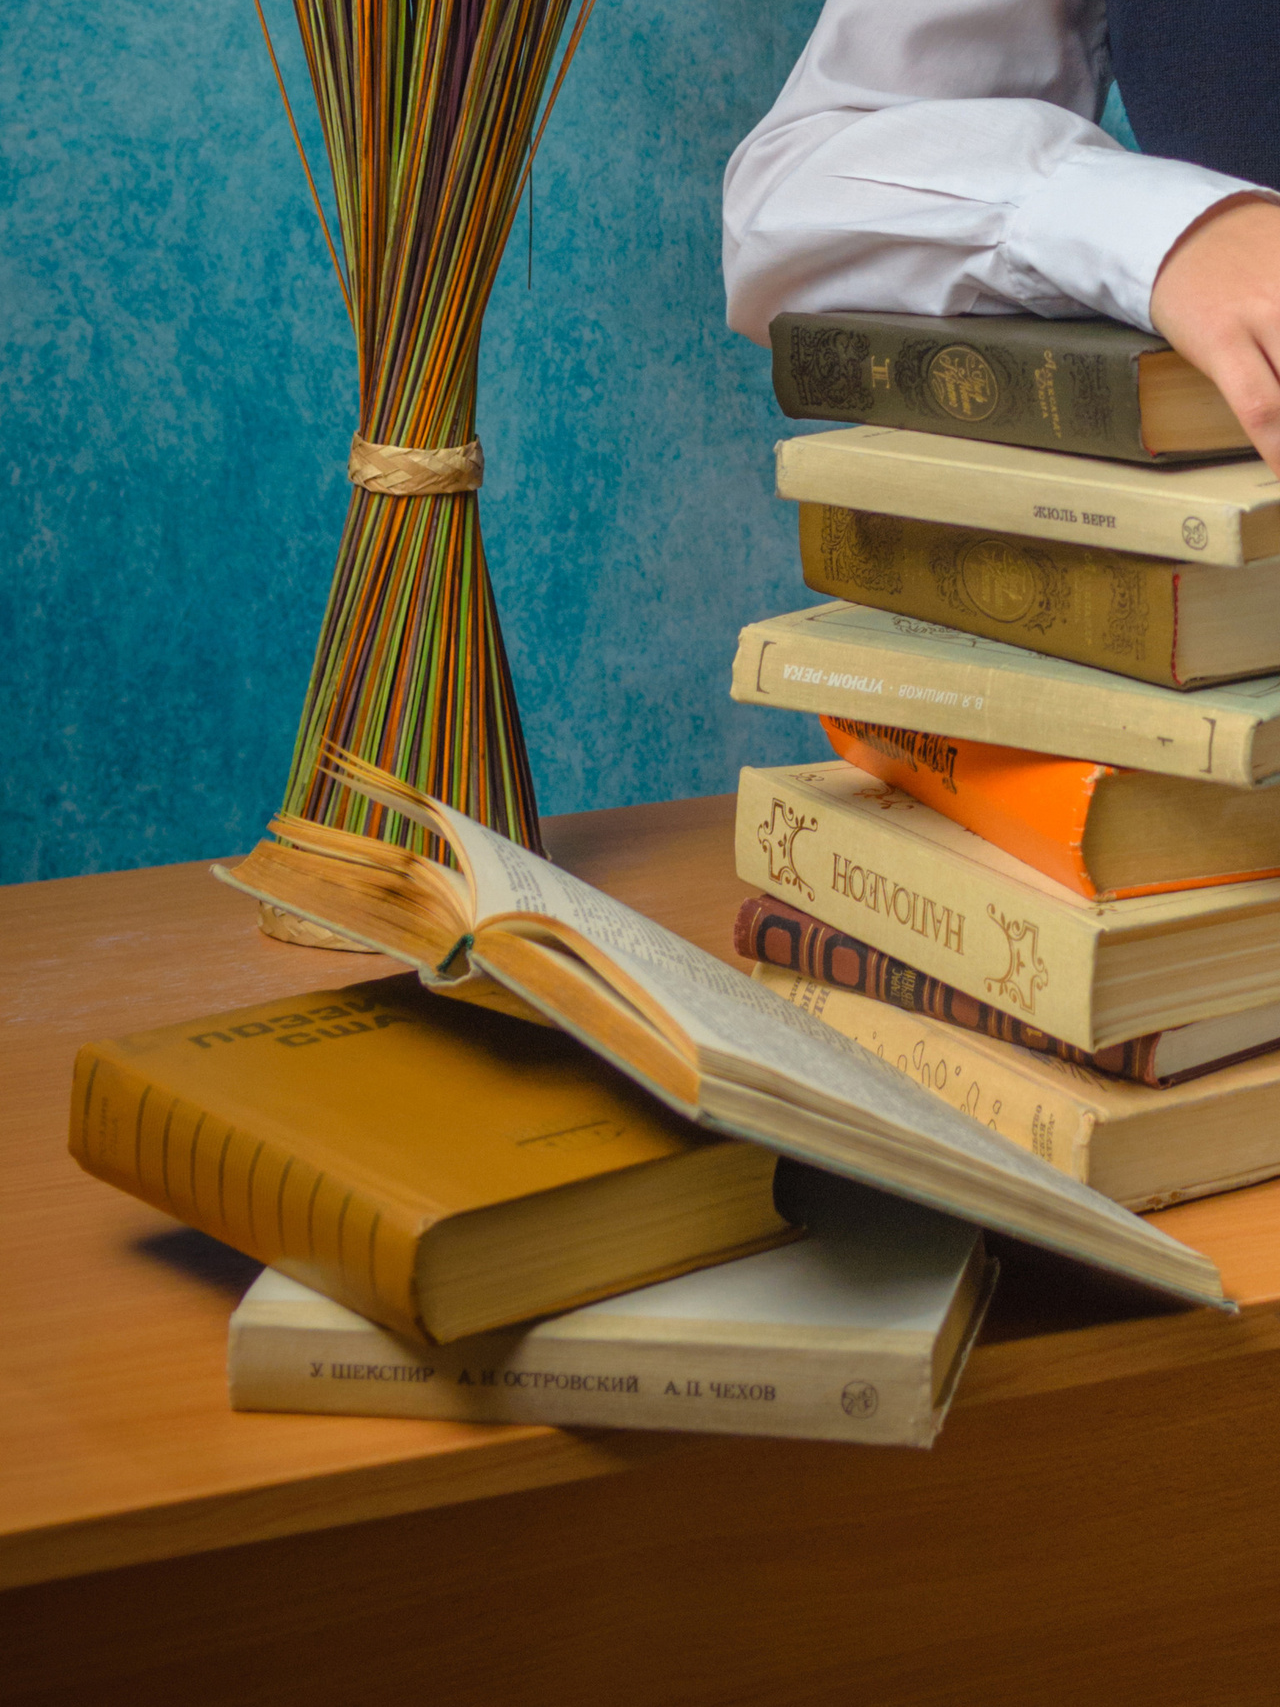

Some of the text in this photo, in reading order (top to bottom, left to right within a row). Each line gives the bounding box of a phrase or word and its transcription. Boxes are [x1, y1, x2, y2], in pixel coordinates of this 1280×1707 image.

[1033, 505, 1117, 529] ЖЮЛЬ ВЕРН
[783, 664, 884, 694] УГРЮМ-РЕКА
[831, 852, 966, 956] НАПОЛЕОН
[187, 999, 384, 1049] ПОЭЗИ
[331, 1363, 435, 1384] ШЕКСПИР
[503, 1371, 640, 1394] ОСТРОВСКИЙ
[709, 1381, 777, 1402] ЧЕХОВ
